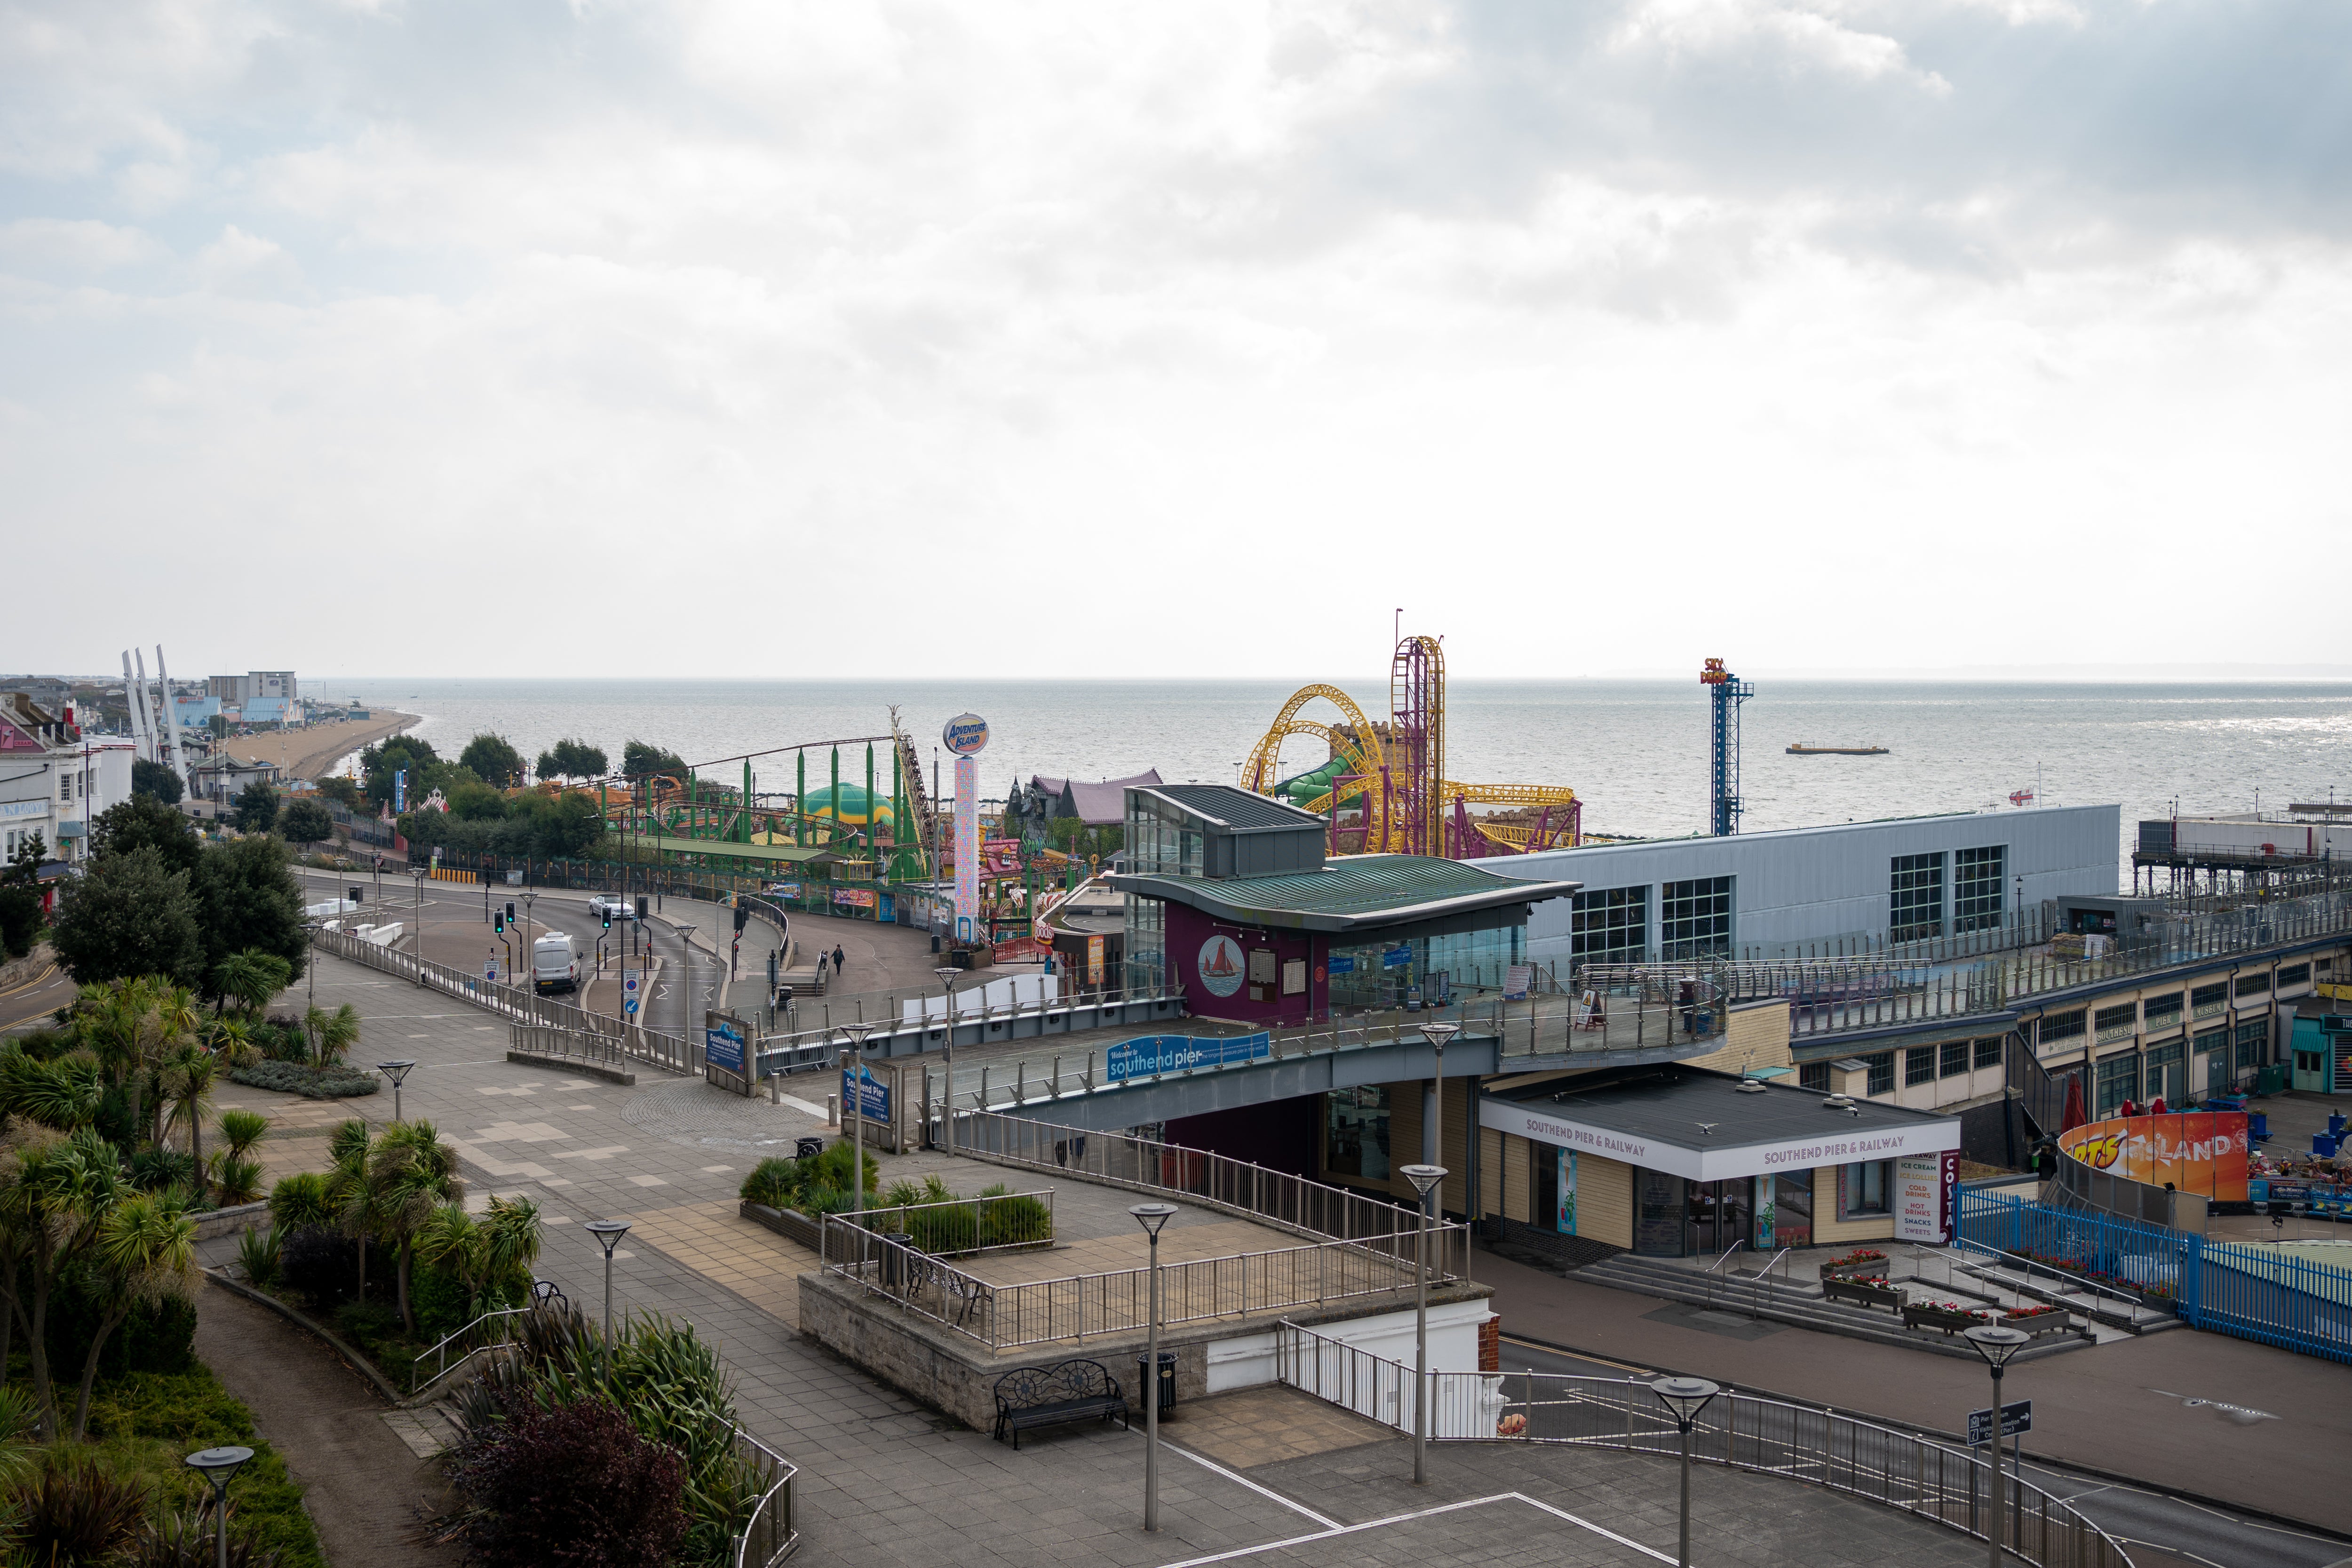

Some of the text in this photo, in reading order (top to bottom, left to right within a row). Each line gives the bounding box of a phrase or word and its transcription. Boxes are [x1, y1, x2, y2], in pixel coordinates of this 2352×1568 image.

[1705, 658, 1723, 670] SKY
[1700, 671, 1727, 685] DROP
[948, 722, 986, 740] ADVENTURE
[955, 735, 979, 750] ISLAND
[2195, 1003, 2221, 1017] MUSEUM
[2155, 1015, 2171, 1027] PIER
[2097, 1025, 2132, 1042] SOUTHEND
[710, 1033, 740, 1050] Southend Pier
[1110, 1051, 1132, 1059] Welcome
[1111, 1051, 1173, 1076] southend
[1175, 1048, 1200, 1068] pier
[873, 1086, 884, 1098] Pier
[1527, 1119, 1645, 1157] SOUTHEND PIER & RAILWAY
[1764, 1136, 1904, 1164] SOUTHEND PIER & RAILWAY
[2138, 1135, 2230, 1162] ISLAND
[2000, 1419, 2020, 1428] ormation
[2000, 1426, 2014, 1435] (Pier)
